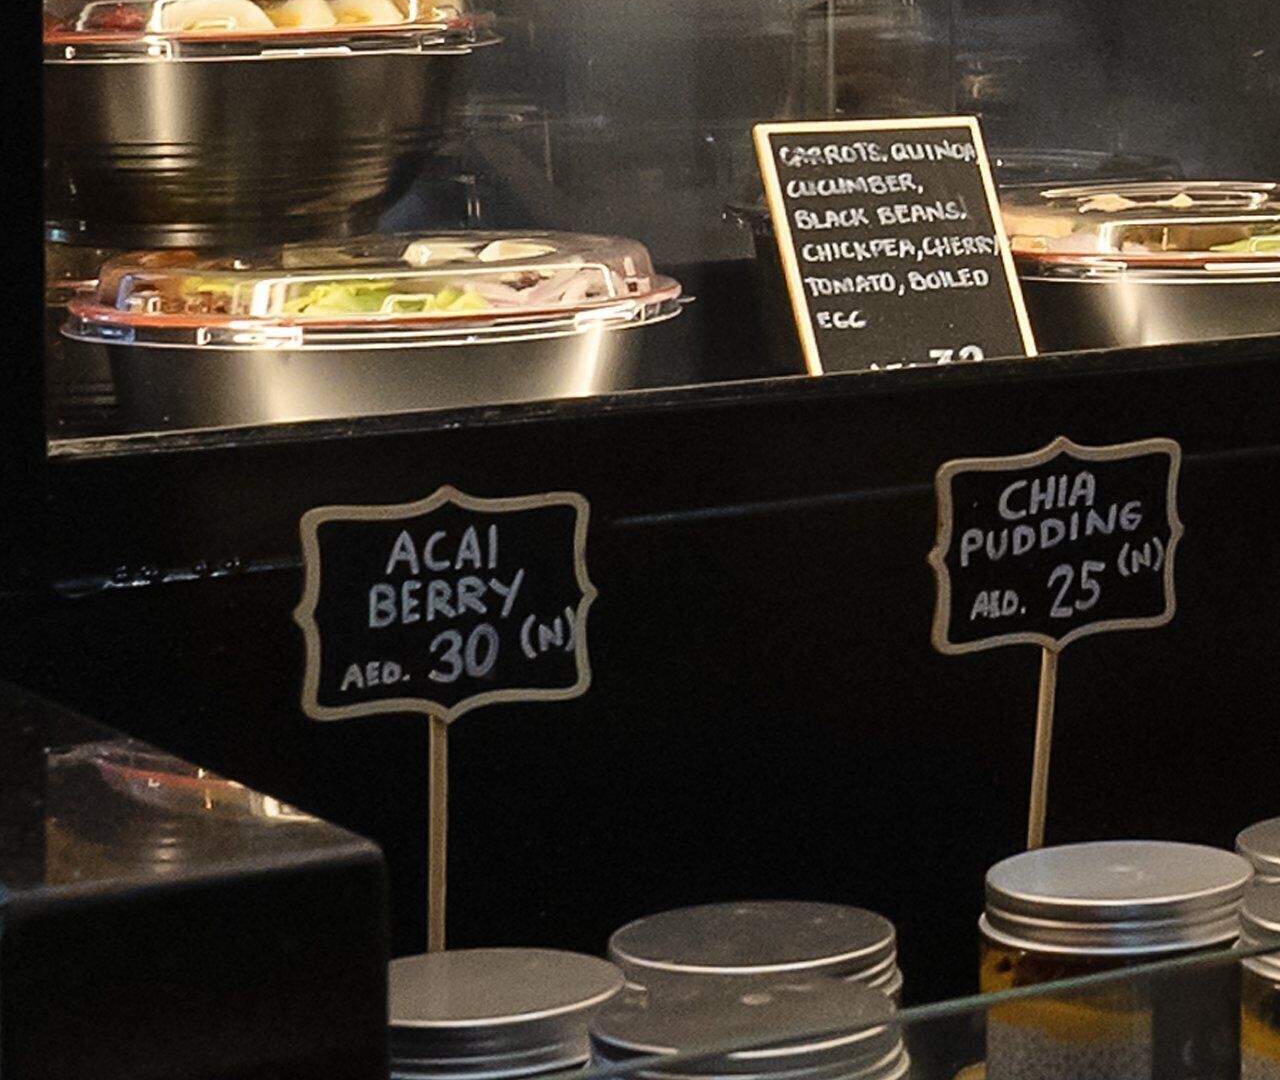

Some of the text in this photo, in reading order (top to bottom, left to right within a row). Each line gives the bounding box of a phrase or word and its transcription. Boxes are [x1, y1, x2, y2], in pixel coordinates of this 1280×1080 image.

[786, 173, 923, 198] CUCUMBER,
[794, 207, 869, 230] BLACK
[804, 269, 989, 297] TOMATO, BOILED
[998, 471, 1097, 520] CHIA
[386, 524, 499, 575] ACAI
[960, 501, 1144, 568] PUDDING
[368, 569, 525, 628] BERRY
[970, 536, 1164, 621] AED. 25 (N)
[340, 606, 577, 691] AED. 30 (N)
